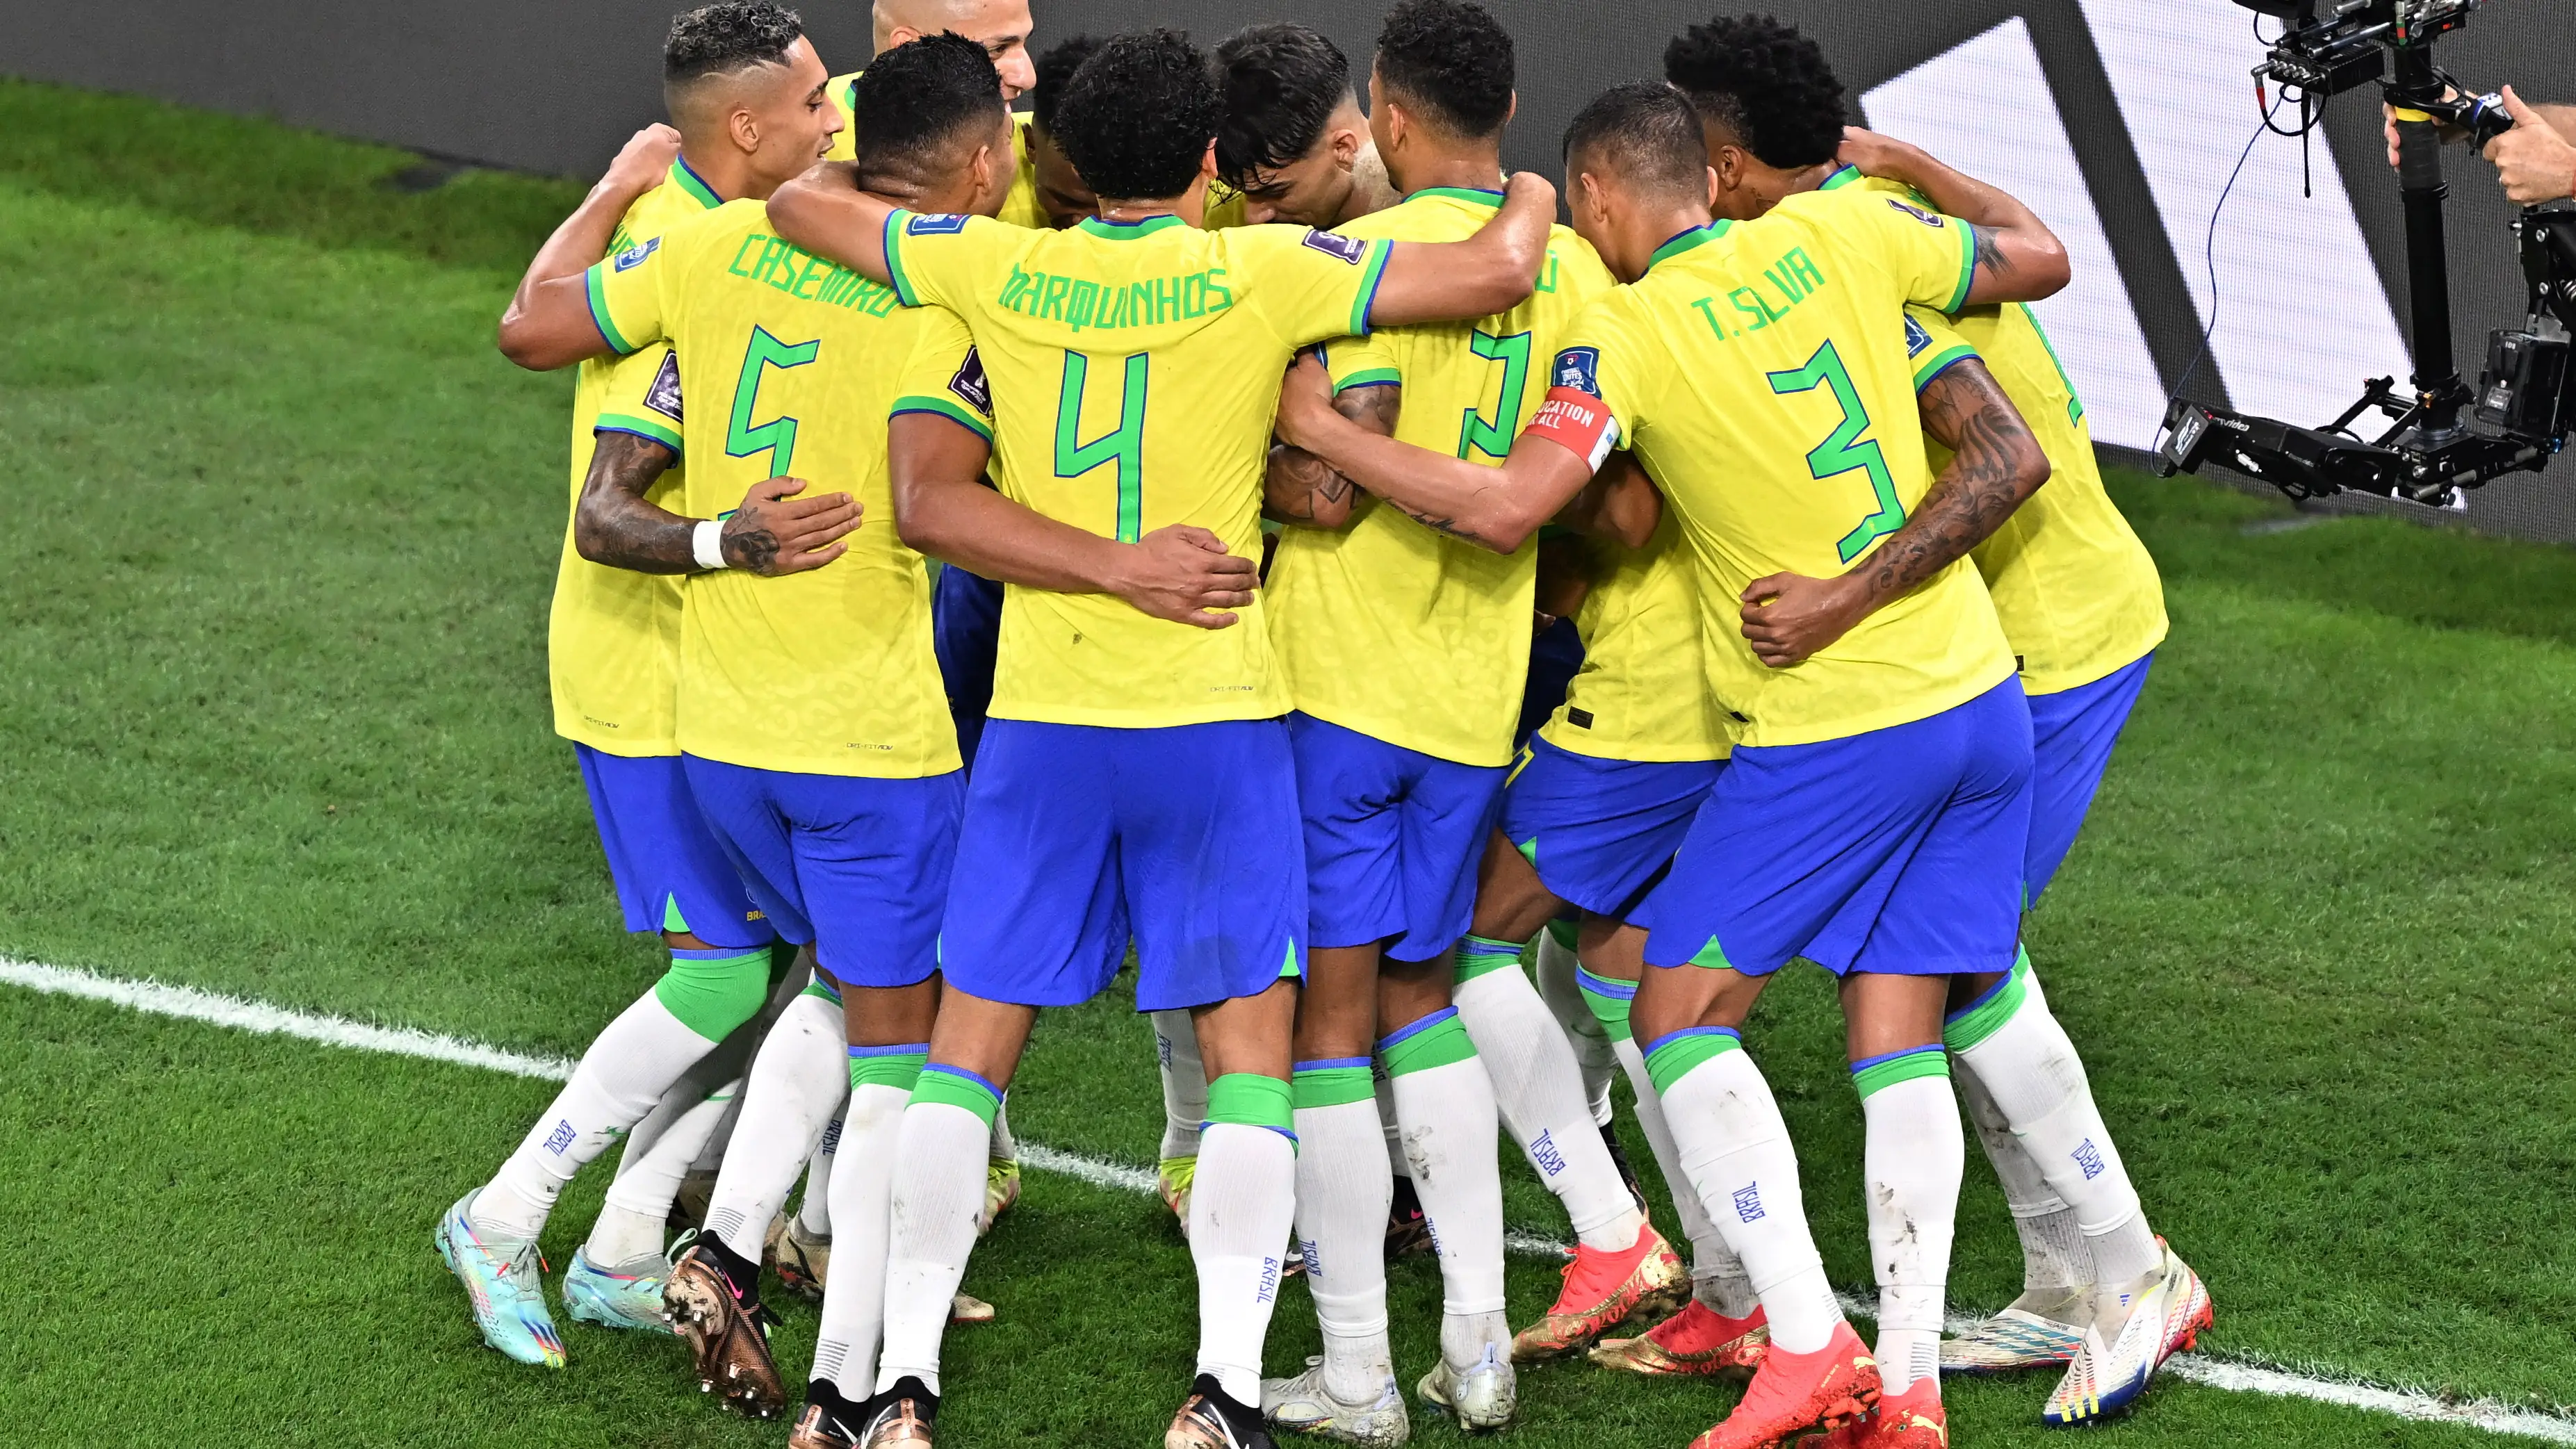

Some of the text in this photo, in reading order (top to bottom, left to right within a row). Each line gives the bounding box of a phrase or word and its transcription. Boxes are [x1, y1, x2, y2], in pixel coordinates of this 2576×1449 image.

[728, 234, 902, 318] CASEMIRO
[998, 262, 1233, 333] MARQUINHOS
[717, 322, 821, 521] 5
[1538, 413, 1560, 429] ALL
[1054, 347, 1149, 545] 4
[1766, 337, 1907, 565] 3
[542, 1119, 577, 1157] BRASIL
[1529, 1128, 1567, 1177] BRASIL
[2071, 1137, 2105, 1181] BRASIL
[1731, 1180, 1766, 1224] BRASIL
[1257, 1256, 1279, 1304] BRASIL
